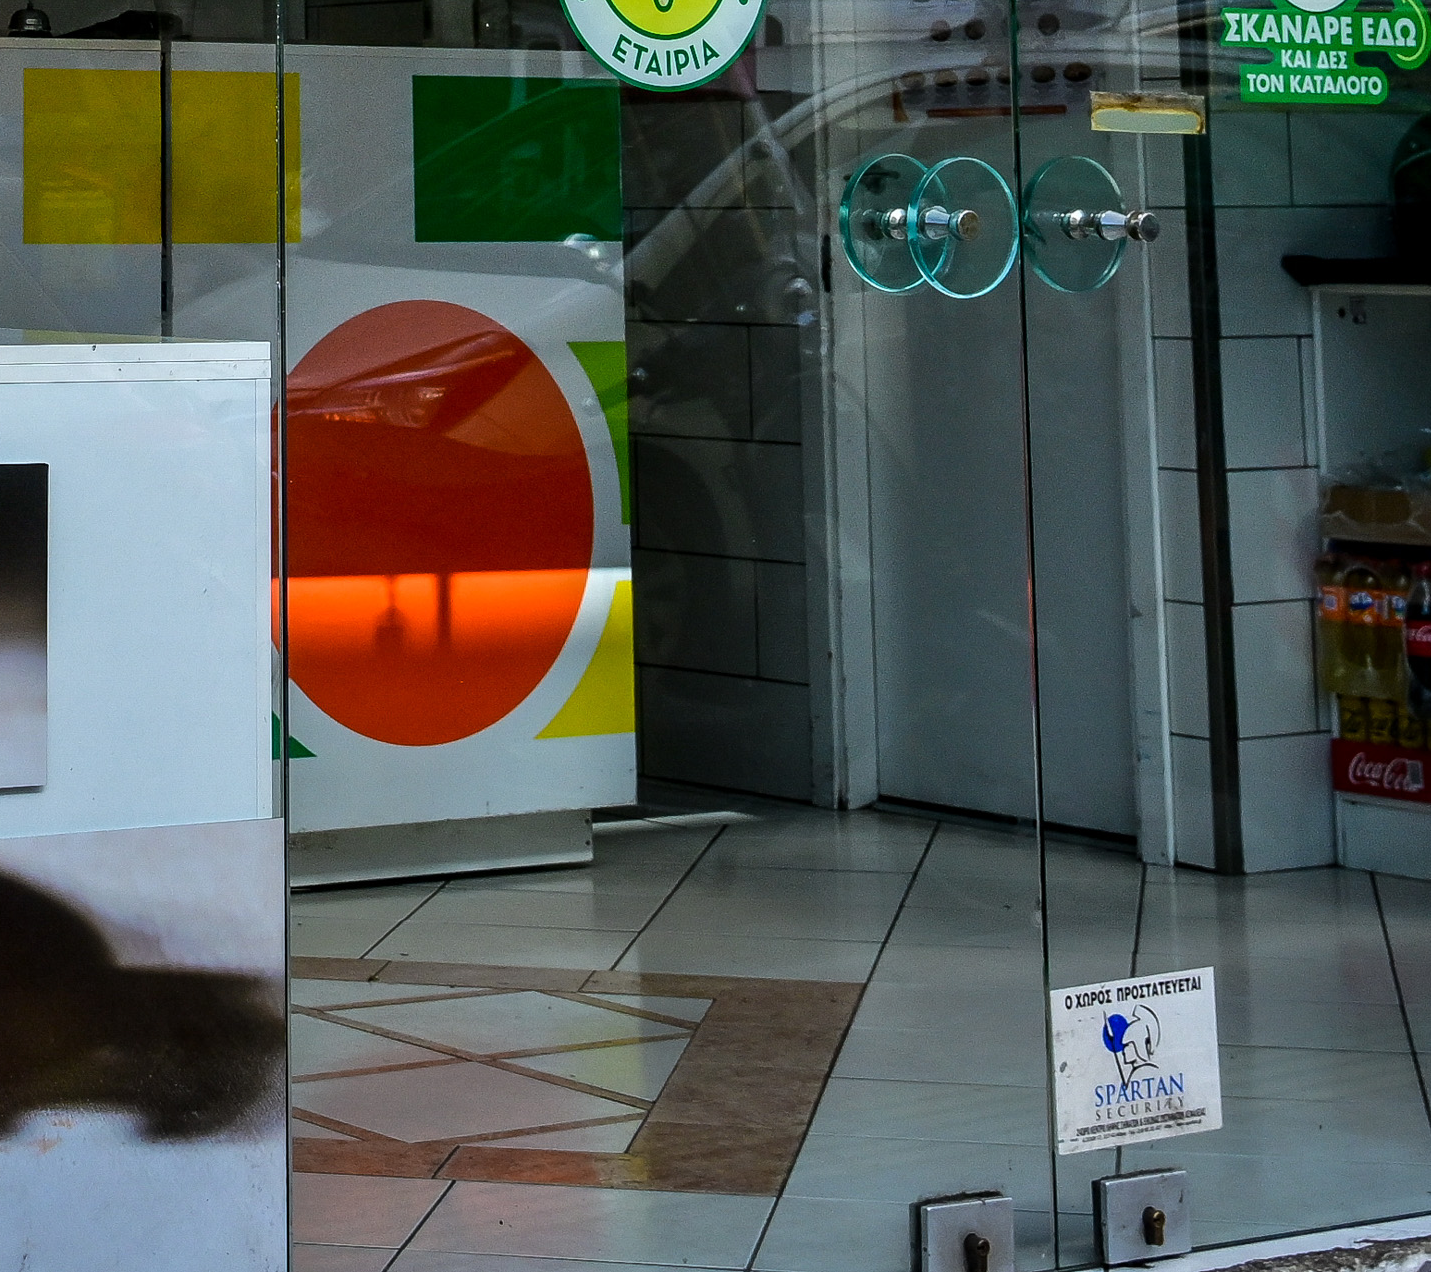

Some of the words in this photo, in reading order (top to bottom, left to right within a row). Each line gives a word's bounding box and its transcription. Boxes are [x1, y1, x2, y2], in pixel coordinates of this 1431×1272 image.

[1224, 12, 1352, 45] ΣΚΑΝΑΡΕ
[1362, 18, 1417, 47] ΕΔΩ
[612, 33, 721, 76] ΕΤΑΙΡΙΑ
[1281, 50, 1311, 68] ΚΑΙ
[1317, 50, 1348, 69] ΔΕΣ
[1246, 73, 1285, 93] ΤΟΝ
[1290, 75, 1383, 95] ΚΑΤΑΛΟΓΟ
[1065, 995, 1073, 1010] Ο
[1116, 976, 1201, 1002] ΠΡΟΣΤΑΤΕΥΕΤΑΙ
[1094, 1073, 1184, 1107] SPARTAN
[1095, 1096, 1184, 1121] SECURITY
